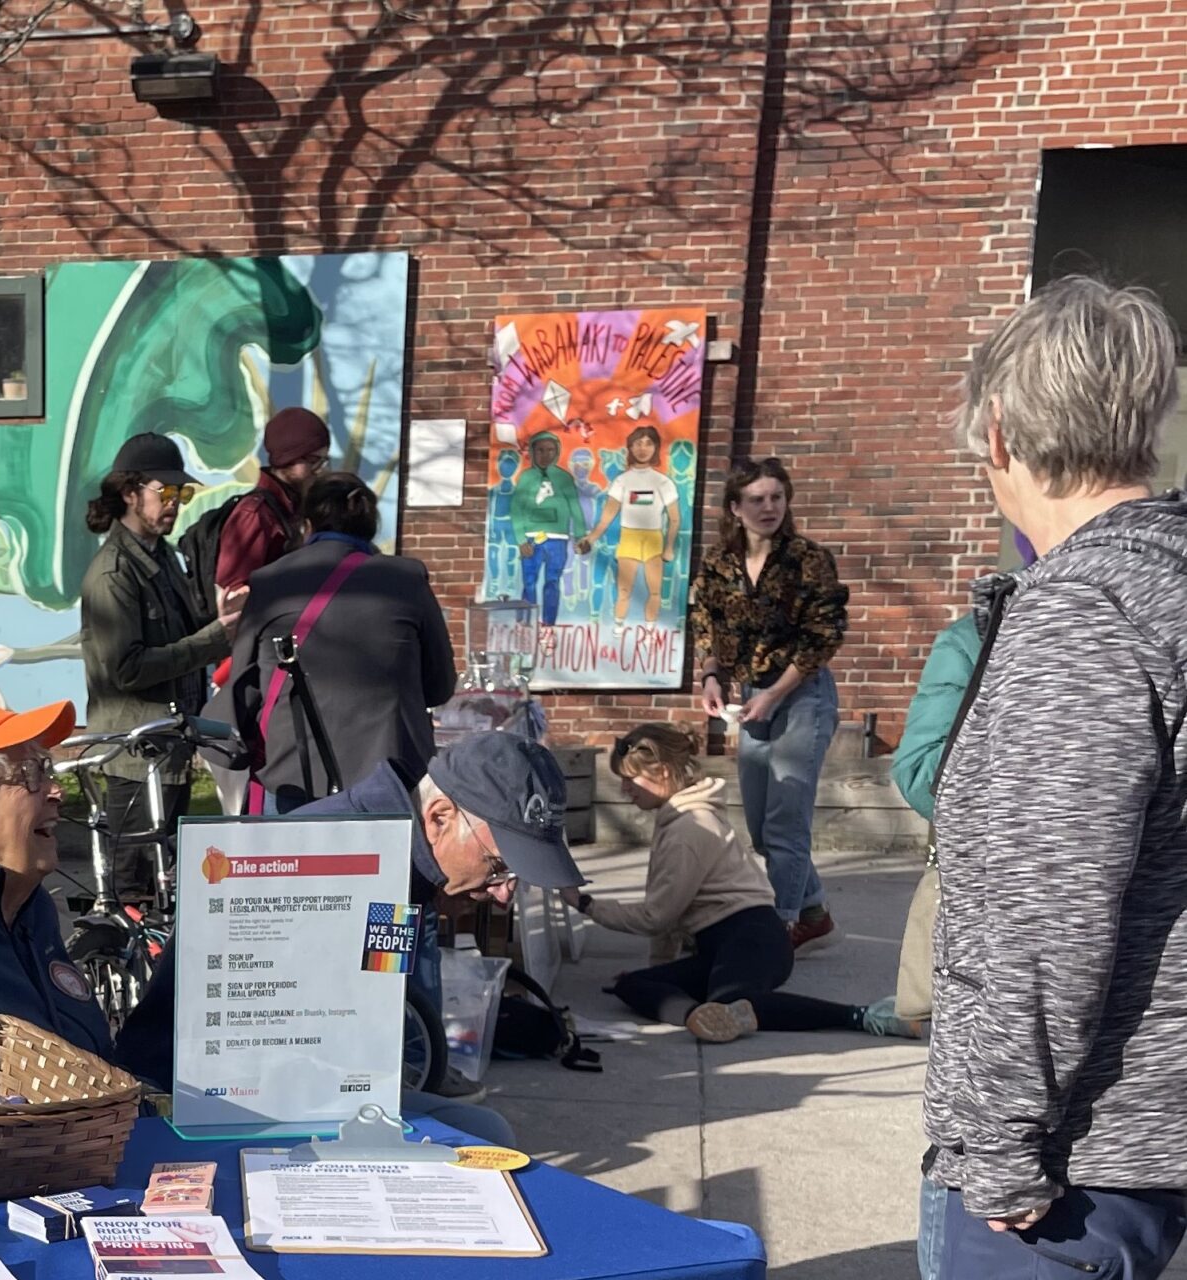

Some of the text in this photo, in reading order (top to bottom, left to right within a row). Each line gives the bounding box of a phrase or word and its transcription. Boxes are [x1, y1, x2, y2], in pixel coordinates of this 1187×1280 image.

[508, 321, 612, 387] WABANAKI
[612, 334, 629, 352] TO
[626, 322, 702, 414] PALESTINE
[620, 624, 681, 675] CRIME
[230, 859, 299, 874] Take action!
[230, 895, 352, 906] ADD YOUR NAME TO SUPPORT PRIORITY
[229, 902, 351, 913] LEGISLATION, PROTECT CIVIL LIBERTIES
[369, 925, 415, 936] WE THE
[367, 935, 414, 951] PEOPLE
[228, 961, 274, 969] TO VOLUNTEER
[227, 982, 243, 990] SIGN
[268, 981, 297, 989] PERIODIC
[227, 990, 246, 998] EMAIL
[227, 1010, 251, 1018] FOLLOW
[253, 1010, 295, 1018] @ACLUMAINE
[226, 1039, 251, 1047] DONATE
[262, 1038, 288, 1046] BECOME
[294, 1037, 321, 1045] MEMBER
[205, 1087, 259, 1097] ACLU Maine
[142, 1220, 182, 1228] YOUR
[97, 1227, 151, 1235] RIGHTS
[102, 1241, 194, 1249] PROTESTING
